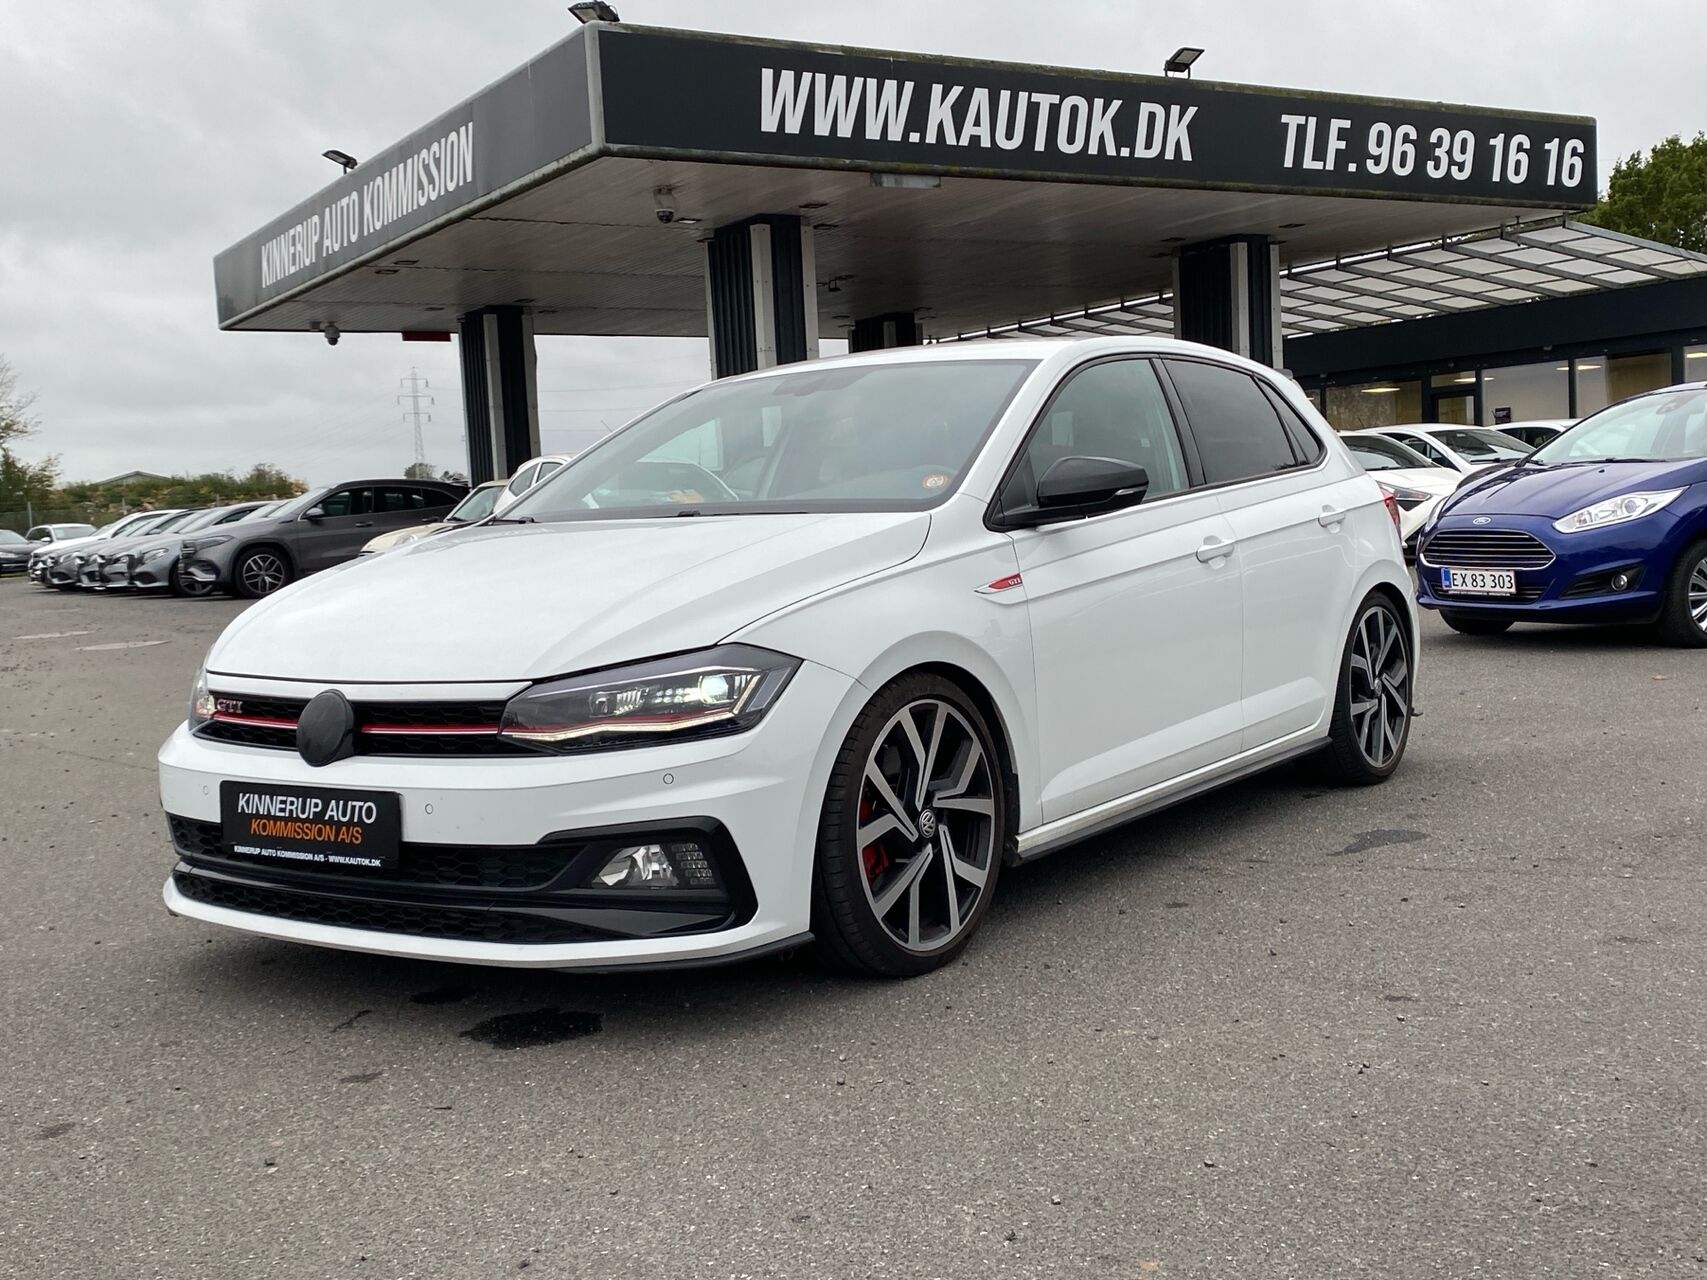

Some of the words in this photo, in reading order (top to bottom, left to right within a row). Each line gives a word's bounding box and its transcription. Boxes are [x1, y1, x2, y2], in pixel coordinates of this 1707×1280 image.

[760, 67, 1198, 162] WWW.KAUTOK.DK
[1281, 114, 1357, 173] TLF.
[1365, 122, 1417, 176] 96
[1426, 127, 1475, 181] 39
[1489, 133, 1531, 184] 16
[1544, 137, 1585, 188] 16
[261, 214, 320, 288] KINNERUP
[323, 190, 359, 257] AUTO
[363, 121, 474, 236] KOMMISSION
[1452, 573, 1468, 587] EX
[1470, 573, 1486, 588] 83
[1489, 574, 1513, 589] 303
[217, 699, 243, 713] GTI
[237, 793, 322, 819] KINNERUP
[324, 799, 377, 824] AUTO
[250, 818, 335, 841] KOMMISSION
[337, 825, 362, 844] A/S
[233, 845, 261, 854] KINNERUP
[261, 847, 277, 857] AUTO
[277, 849, 313, 861] KOMMISSION
[313, 853, 325, 862] A/S
[328, 855, 381, 867] WWW.KAUTOK.DK
